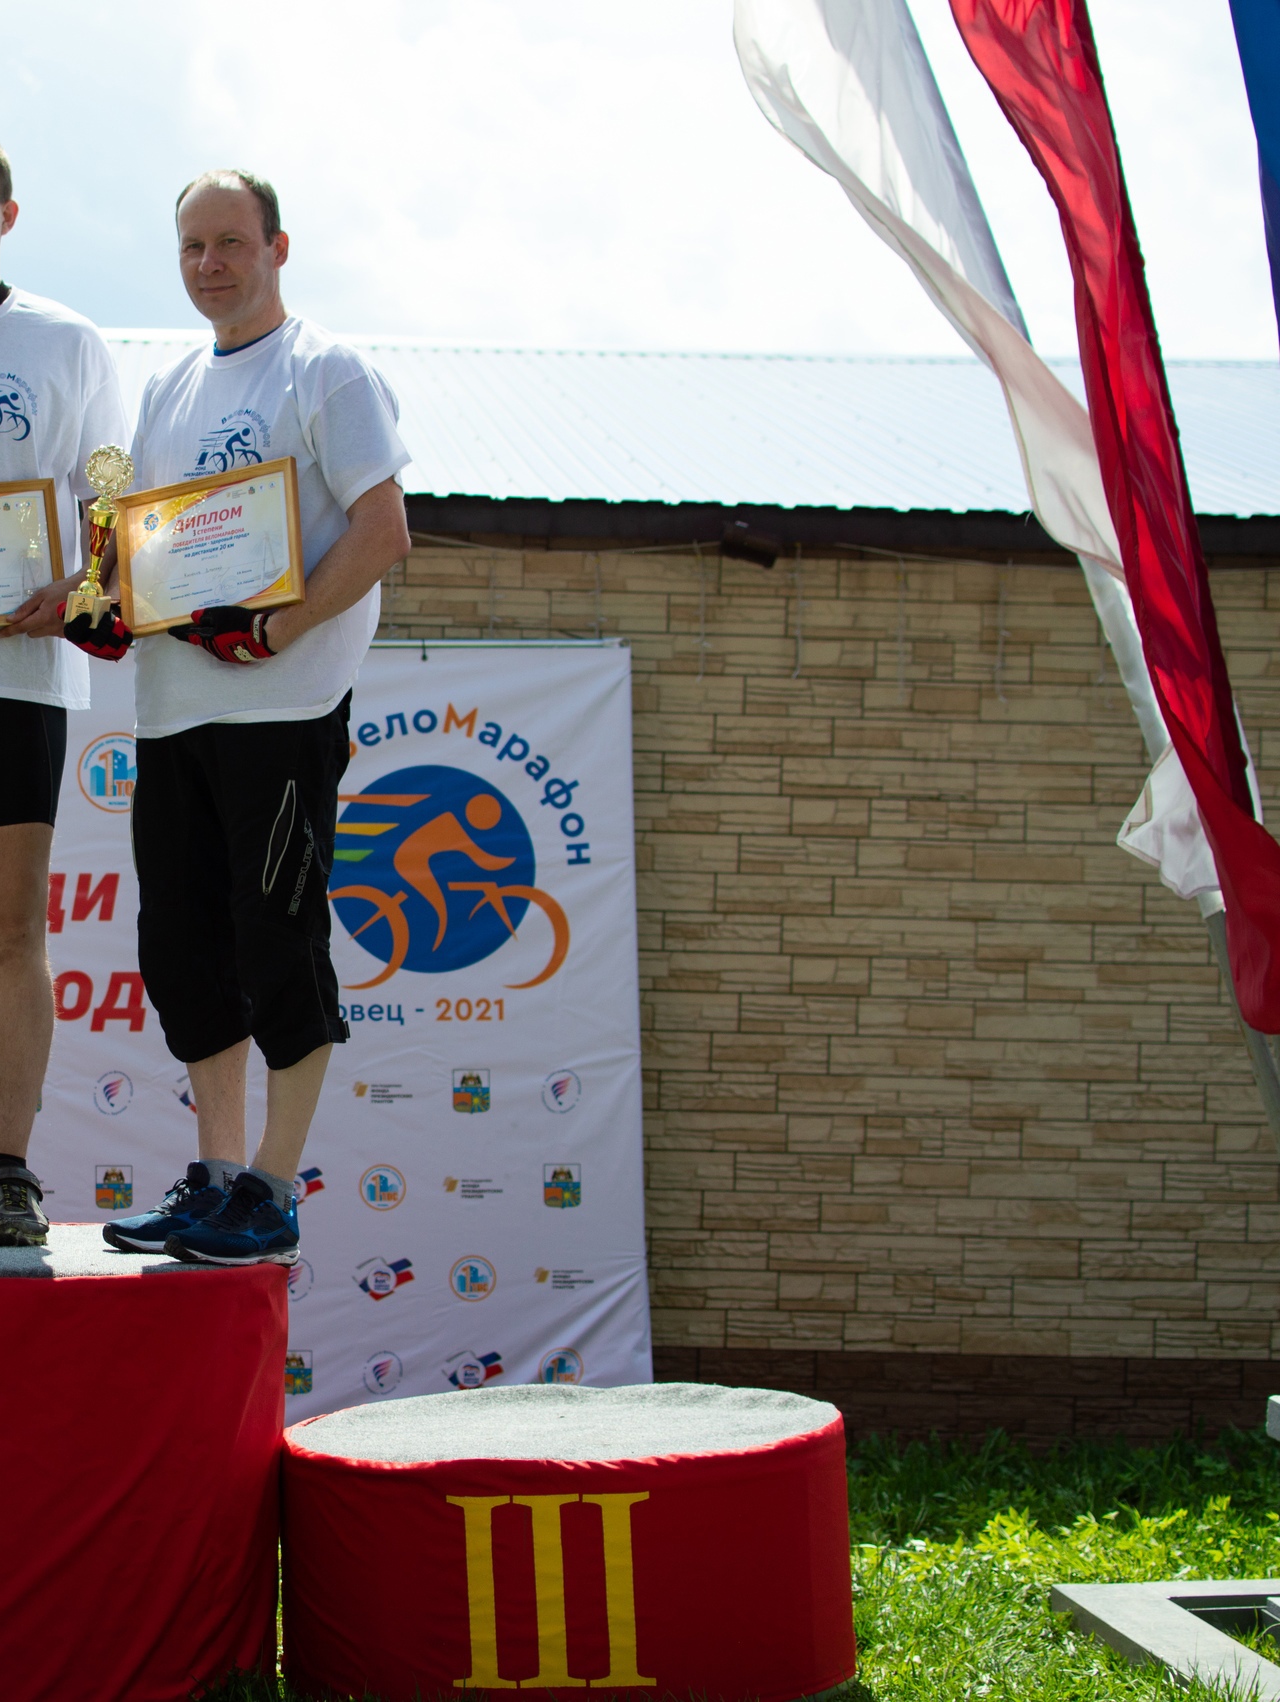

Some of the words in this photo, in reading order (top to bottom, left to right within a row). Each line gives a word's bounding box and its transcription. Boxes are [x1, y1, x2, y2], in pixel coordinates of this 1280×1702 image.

[172, 505, 243, 535] ДИПЛОМ
[197, 525, 223, 535] степени
[349, 702, 591, 866] елоМарафон
[435, 997, 505, 1022] 2021
[446, 1491, 657, 1689] III
